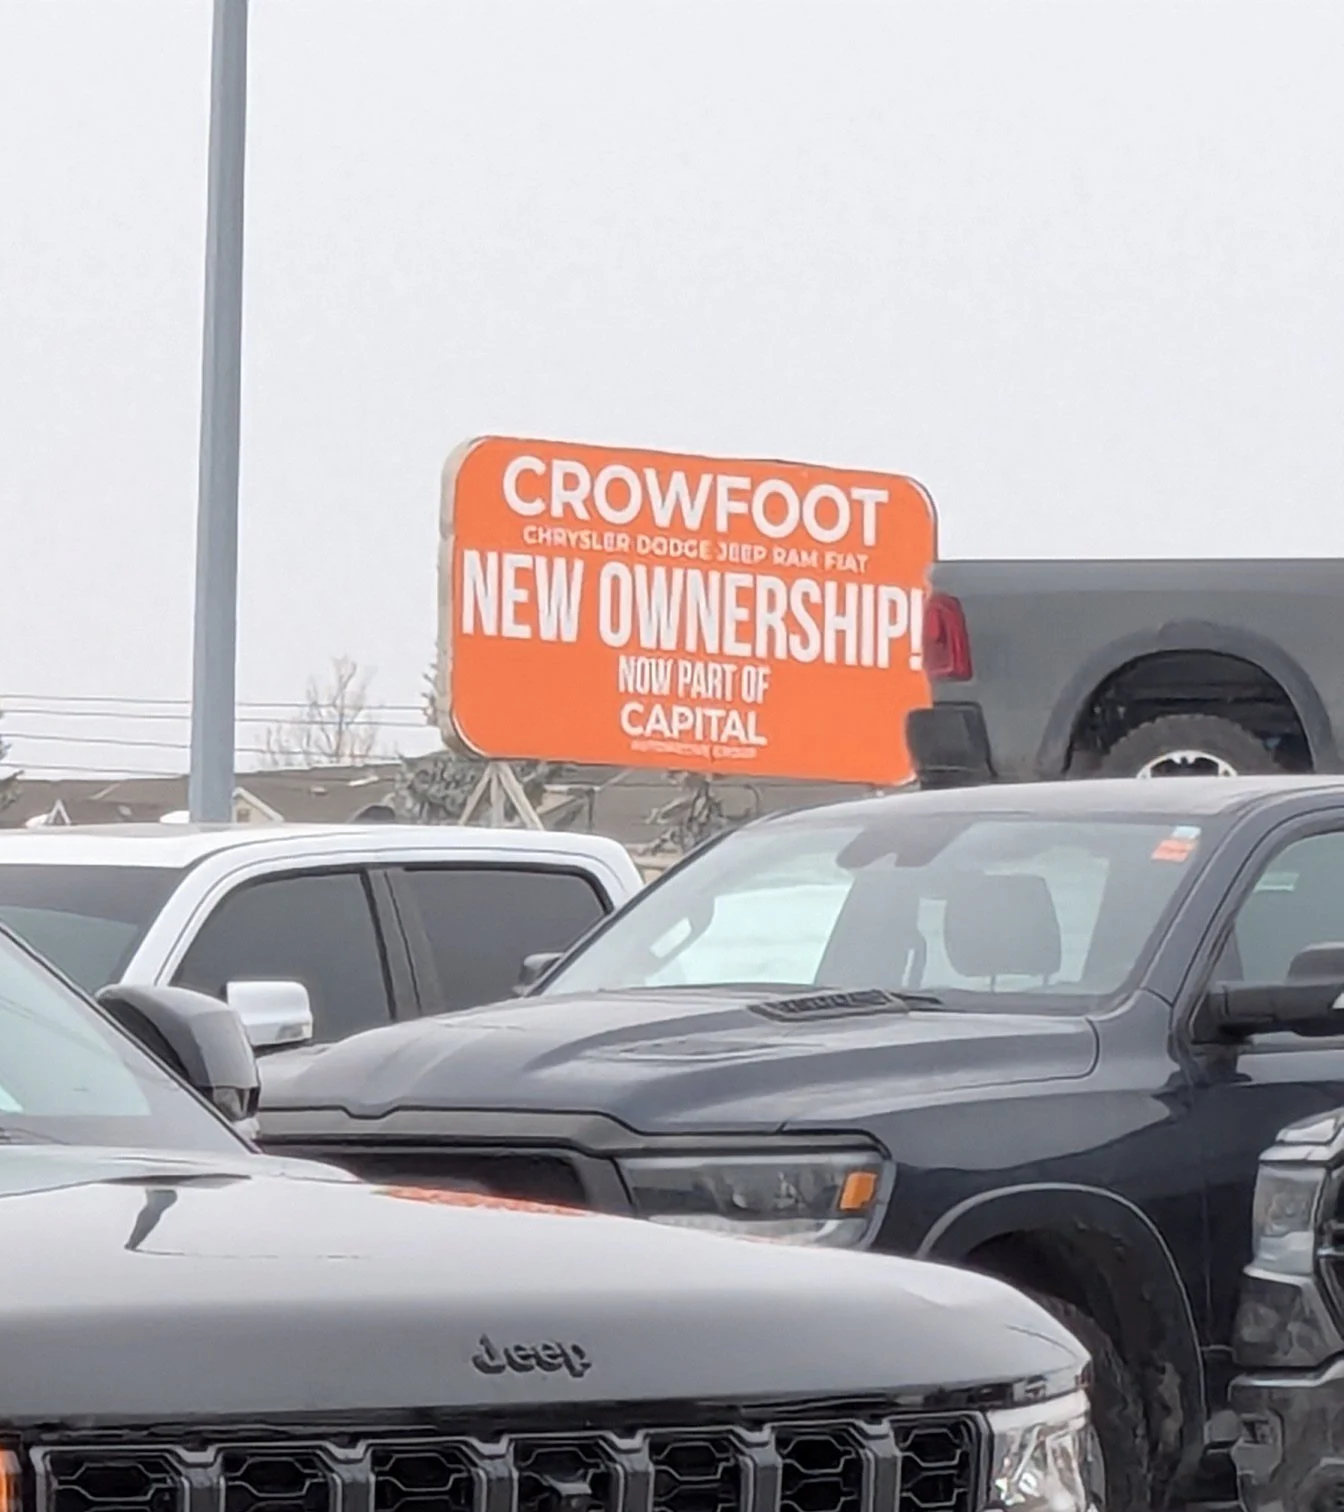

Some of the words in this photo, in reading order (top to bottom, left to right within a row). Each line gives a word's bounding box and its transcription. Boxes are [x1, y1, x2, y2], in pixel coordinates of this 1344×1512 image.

[502, 455, 890, 547] CROWFOOT
[523, 525, 630, 553] CHRYSLER
[637, 534, 711, 560] DODGE
[716, 543, 767, 565] JEEP
[772, 549, 818, 569] RAM
[824, 553, 869, 574] FIAT
[461, 549, 584, 643] NEW
[598, 564, 923, 670] OWNERSHIP!
[618, 655, 674, 696] NOW
[677, 659, 738, 702] PART
[741, 664, 772, 704] OF
[620, 701, 768, 745] CAPITAL
[471, 1333, 592, 1379] Jeep
